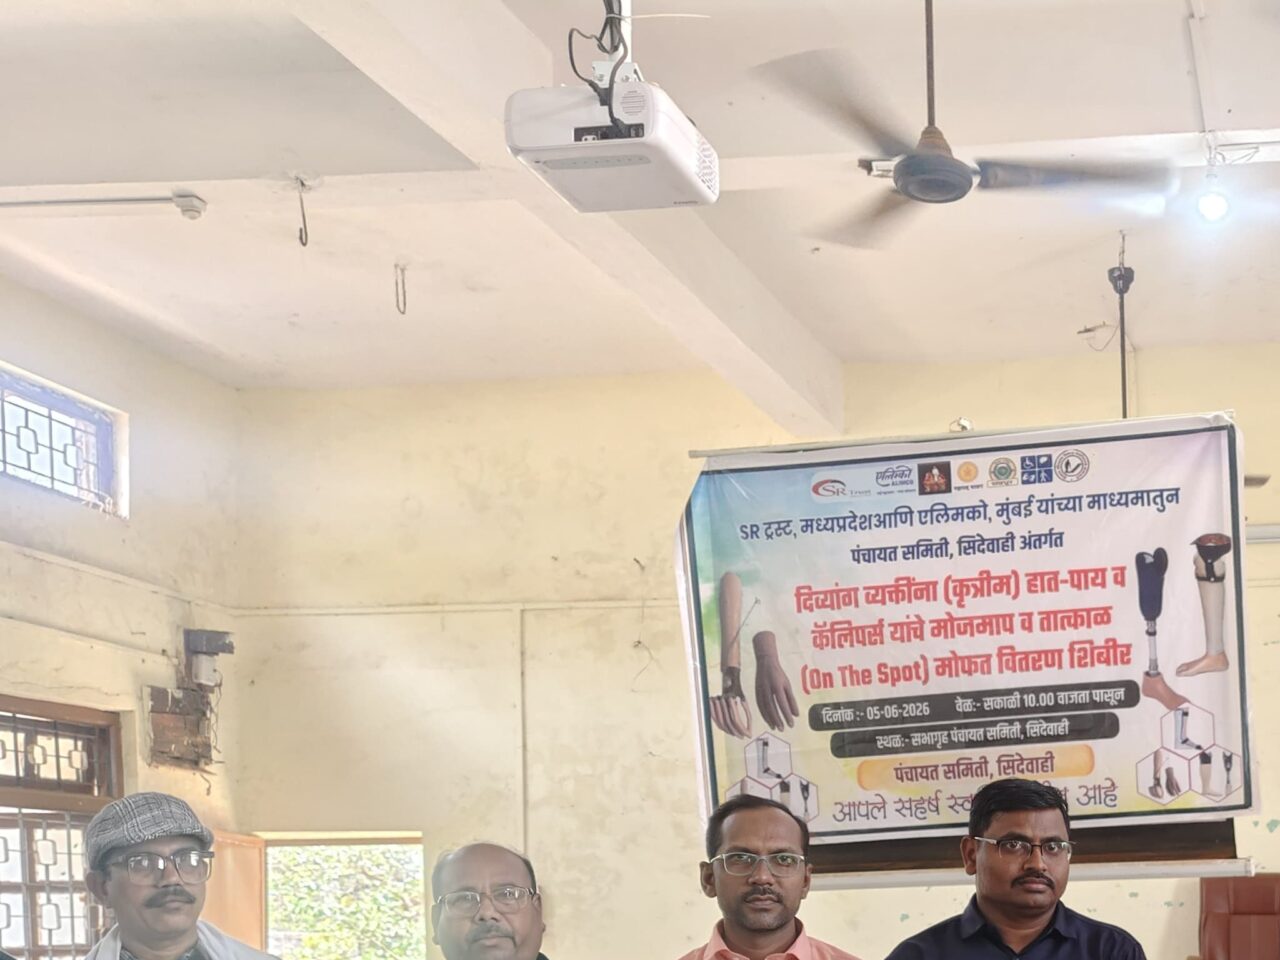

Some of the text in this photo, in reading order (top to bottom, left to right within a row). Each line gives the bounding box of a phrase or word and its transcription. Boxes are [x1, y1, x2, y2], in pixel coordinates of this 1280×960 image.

[821, 484, 847, 497] SR
[739, 524, 760, 540] SR
[763, 520, 797, 540] ट्रस्ट,
[917, 499, 992, 525] एलिमको,
[995, 494, 1035, 525] मुंबई
[1036, 493, 1083, 515] यांच्या
[1086, 487, 1181, 513] माध्यमातुन
[850, 527, 1065, 564] पंचायत समिती, सिदेवाही अंतर्गत
[794, 582, 859, 613] दिव्यांग
[943, 569, 1020, 608] (कृत्रीम)
[1024, 567, 1107, 593] हात-पाय
[1111, 566, 1127, 588] व
[811, 606, 1113, 650] कॅलिपर्स यांचे मोजमाप व तात्काळ
[800, 637, 1132, 695] (On The Spot) मोफत वितरण शिबीर
[821, 706, 854, 724] दिनांक
[866, 702, 930, 720] 05-06-2026
[982, 691, 1021, 711] सकाळी
[1022, 692, 1054, 708] 10.00
[1056, 690, 1090, 706] वाजता
[1091, 687, 1126, 705] पासून
[910, 730, 949, 750] सभागृह
[950, 726, 984, 743] पंचायत
[986, 722, 1025, 741] समिती,
[1025, 717, 1070, 738] सिदेवाही
[893, 750, 1055, 783] पंचायत समिती, सिदेवाही
[832, 793, 888, 822] आपले
[893, 789, 943, 820] सहर्ष
[1075, 777, 1118, 808] आहे
